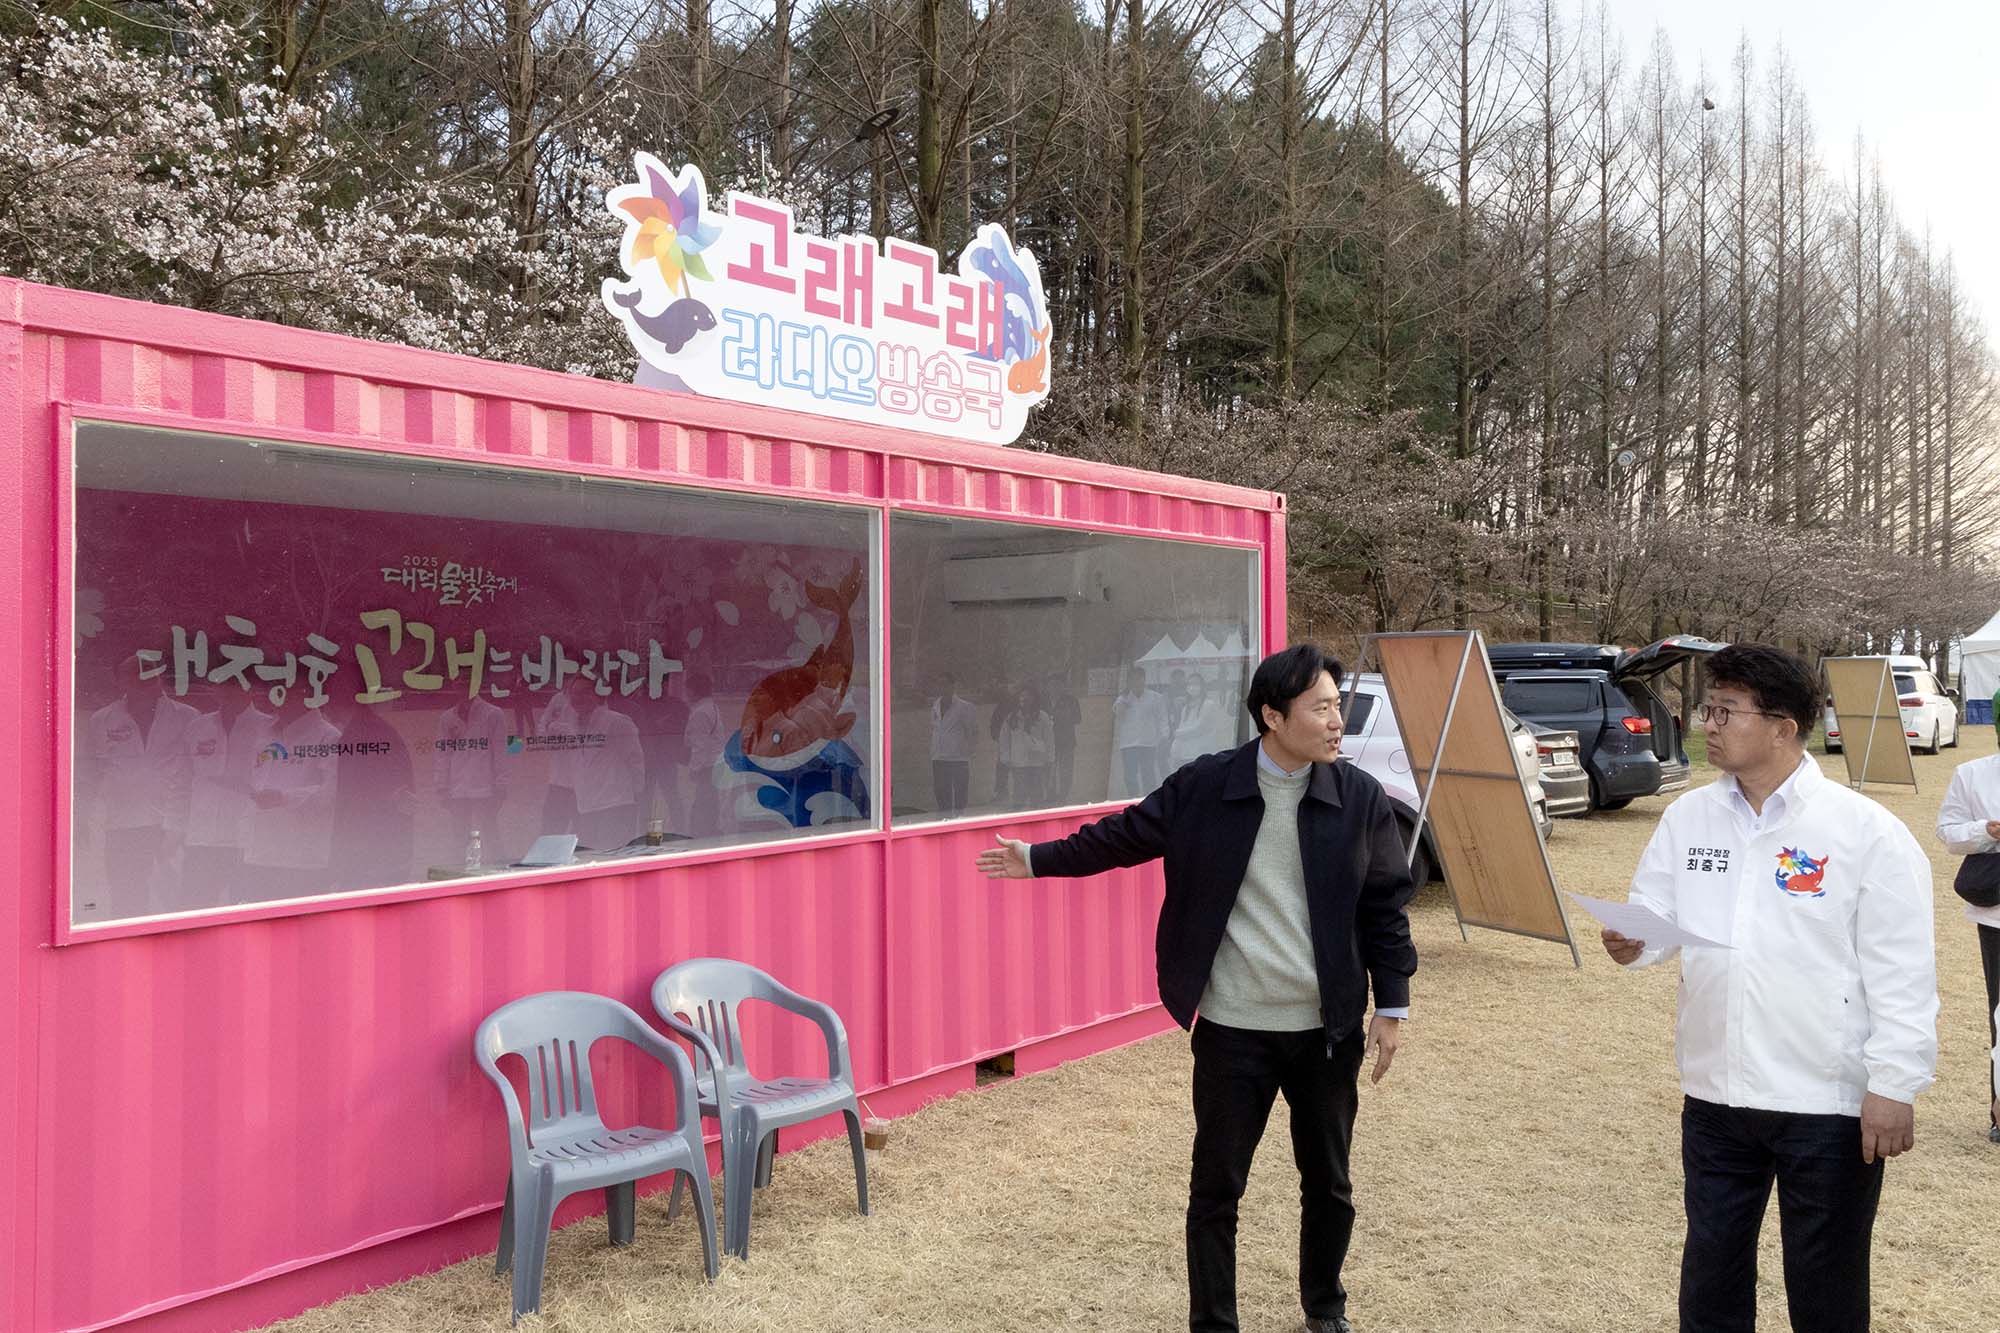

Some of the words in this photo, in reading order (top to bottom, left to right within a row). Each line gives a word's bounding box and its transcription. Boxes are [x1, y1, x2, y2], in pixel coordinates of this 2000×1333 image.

[727, 199, 1004, 361] 고래고래
[402, 555, 439, 567] 2025
[135, 615, 340, 708] 대청호
[354, 608, 514, 704] 고래는
[521, 635, 684, 700] 바란다
[293, 742, 354, 758] 대전광역시
[356, 741, 391, 756] 대덕구
[435, 736, 489, 752] 대덕문화원
[1688, 847, 1731, 859] 대덕구청장
